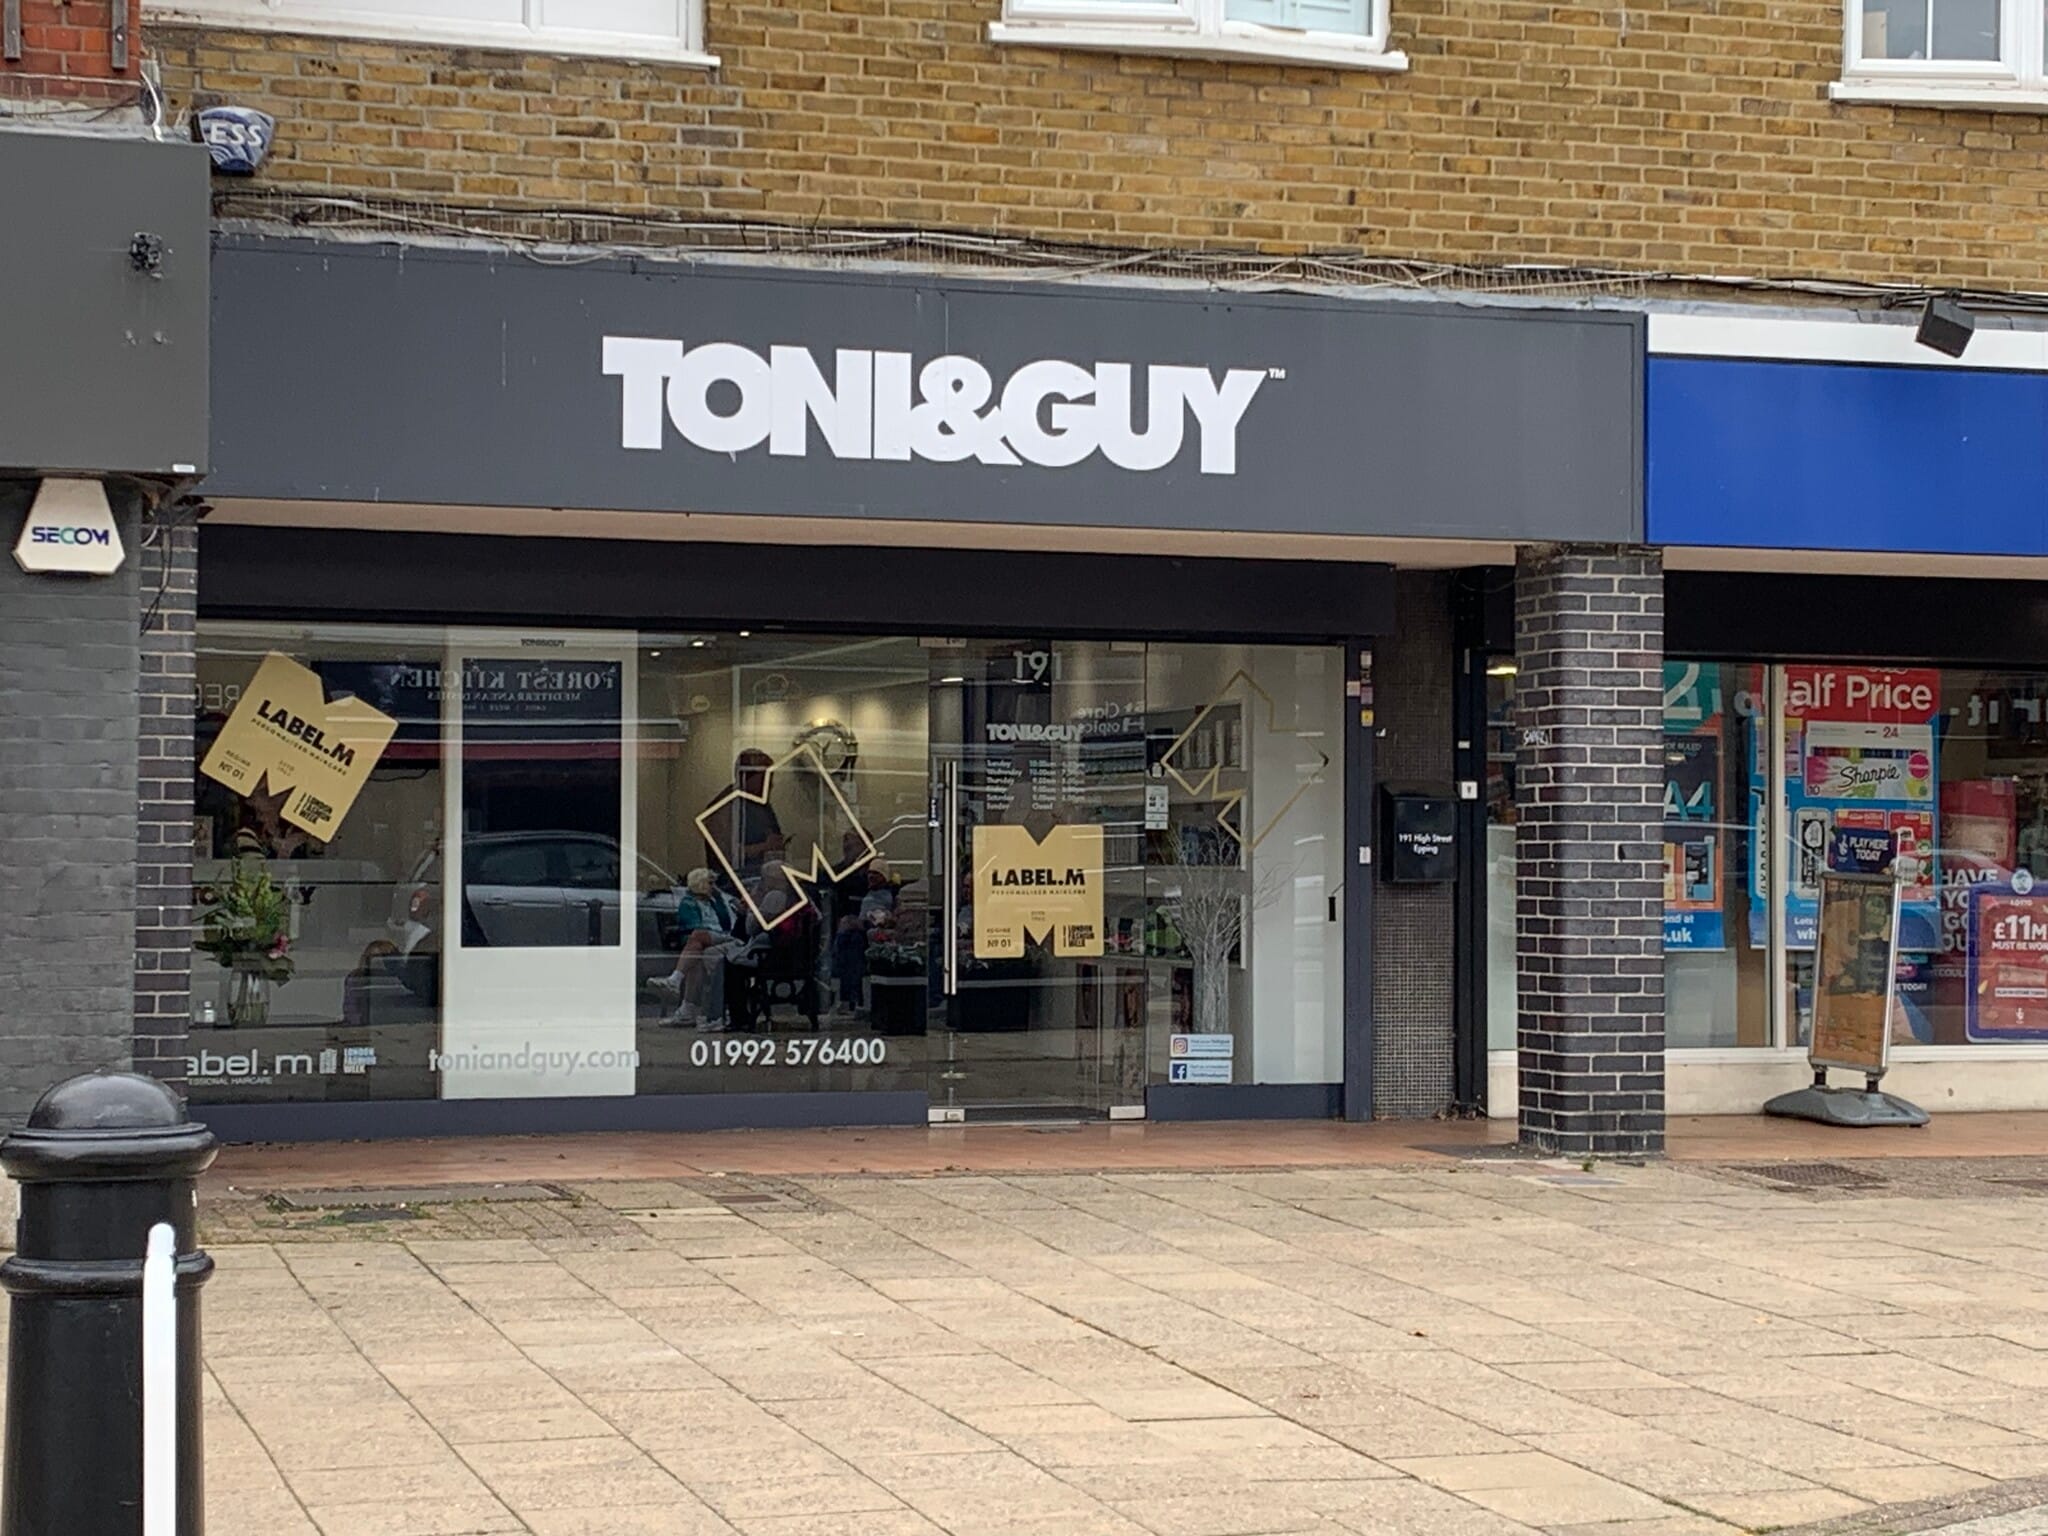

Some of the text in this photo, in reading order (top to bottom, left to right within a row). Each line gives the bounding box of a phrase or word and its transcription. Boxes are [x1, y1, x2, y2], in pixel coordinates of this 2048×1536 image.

[210, 123, 262, 146] ESS
[32, 526, 109, 546] SECOM
[1013, 651, 1062, 681] 191
[1847, 675, 1933, 711] Price
[257, 700, 356, 767] LABEL.M
[986, 724, 1082, 742] TONI&GUY
[1840, 765, 1901, 789] Sharpie
[1664, 780, 1714, 822] A4
[1398, 832, 1453, 844] 191 High Street
[1413, 844, 1439, 855] Epping
[991, 868, 1085, 887] LABEL.M
[186, 1049, 312, 1076] abel.m
[429, 1042, 640, 1081] toniandguy.com
[691, 1038, 886, 1066] 01992 576400
